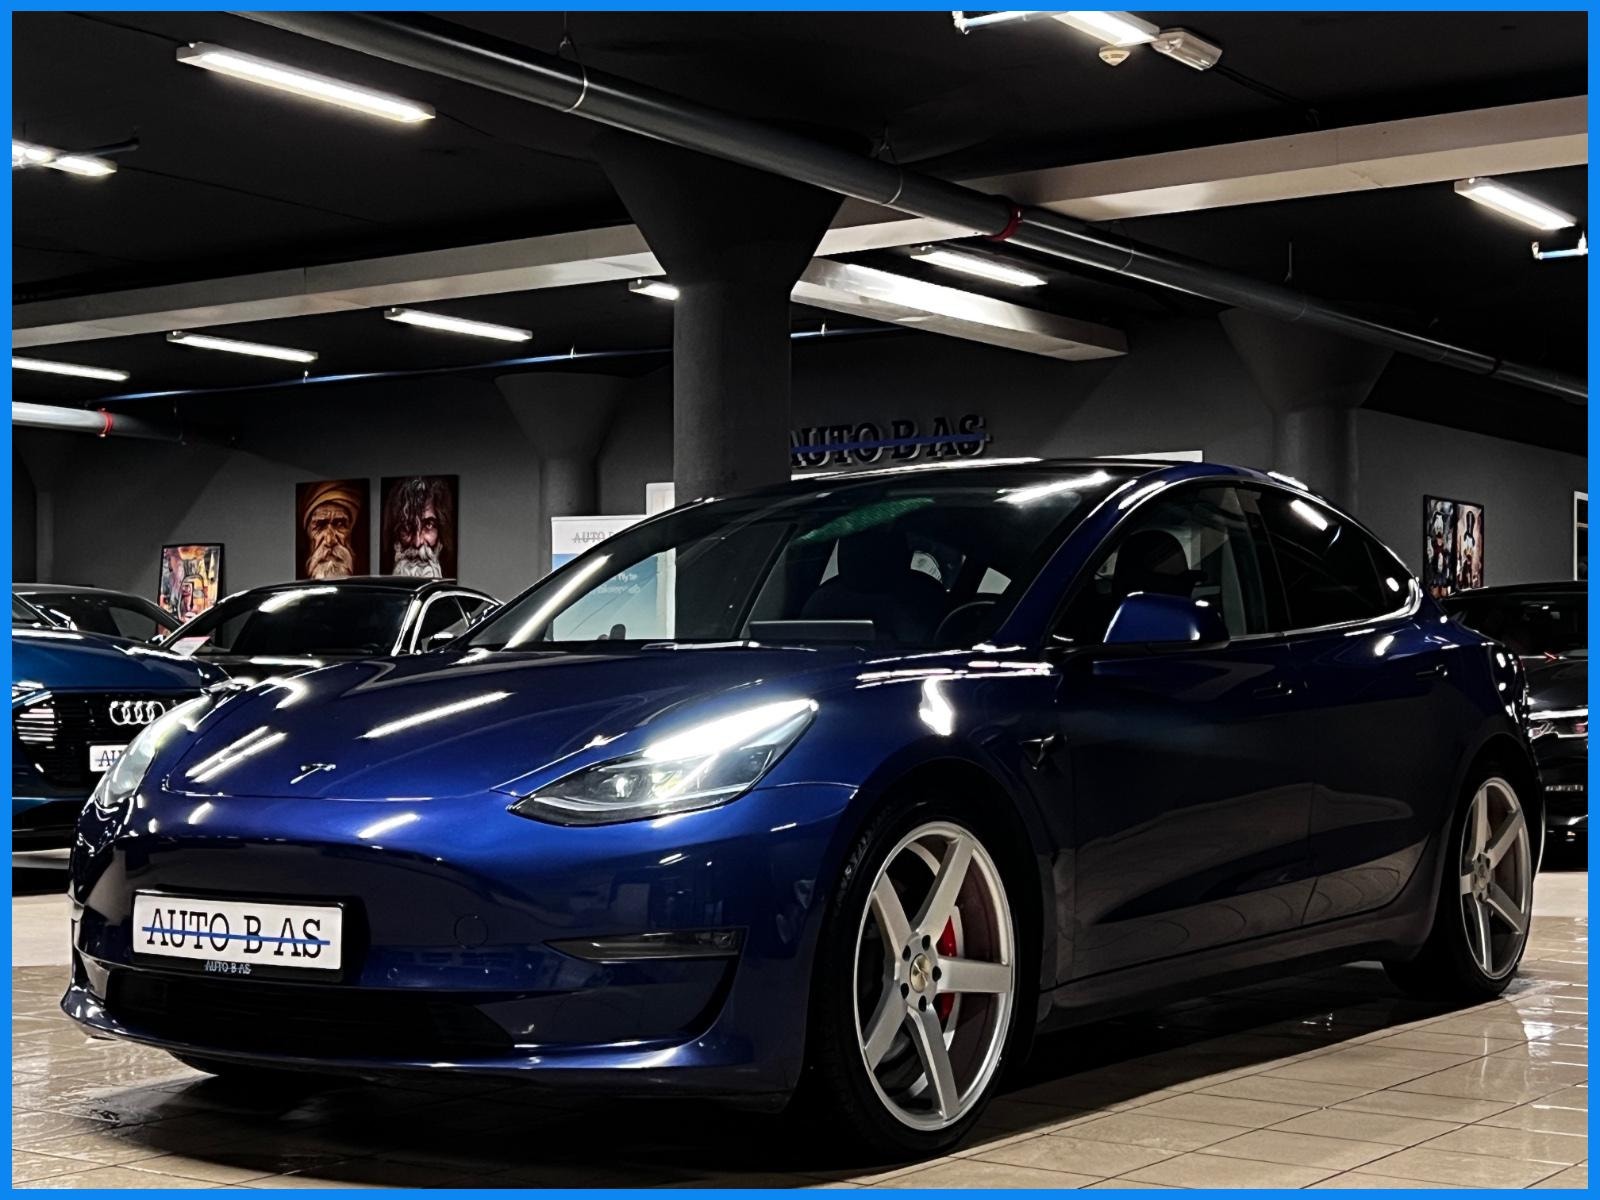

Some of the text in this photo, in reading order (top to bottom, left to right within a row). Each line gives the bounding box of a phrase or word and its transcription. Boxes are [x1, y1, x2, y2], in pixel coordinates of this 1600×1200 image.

[891, 420, 921, 459] B
[927, 415, 986, 459] AS
[573, 531, 605, 544] AUTO
[146, 908, 322, 959] AUTO B AS
[205, 960, 251, 975] AUTO B AS
